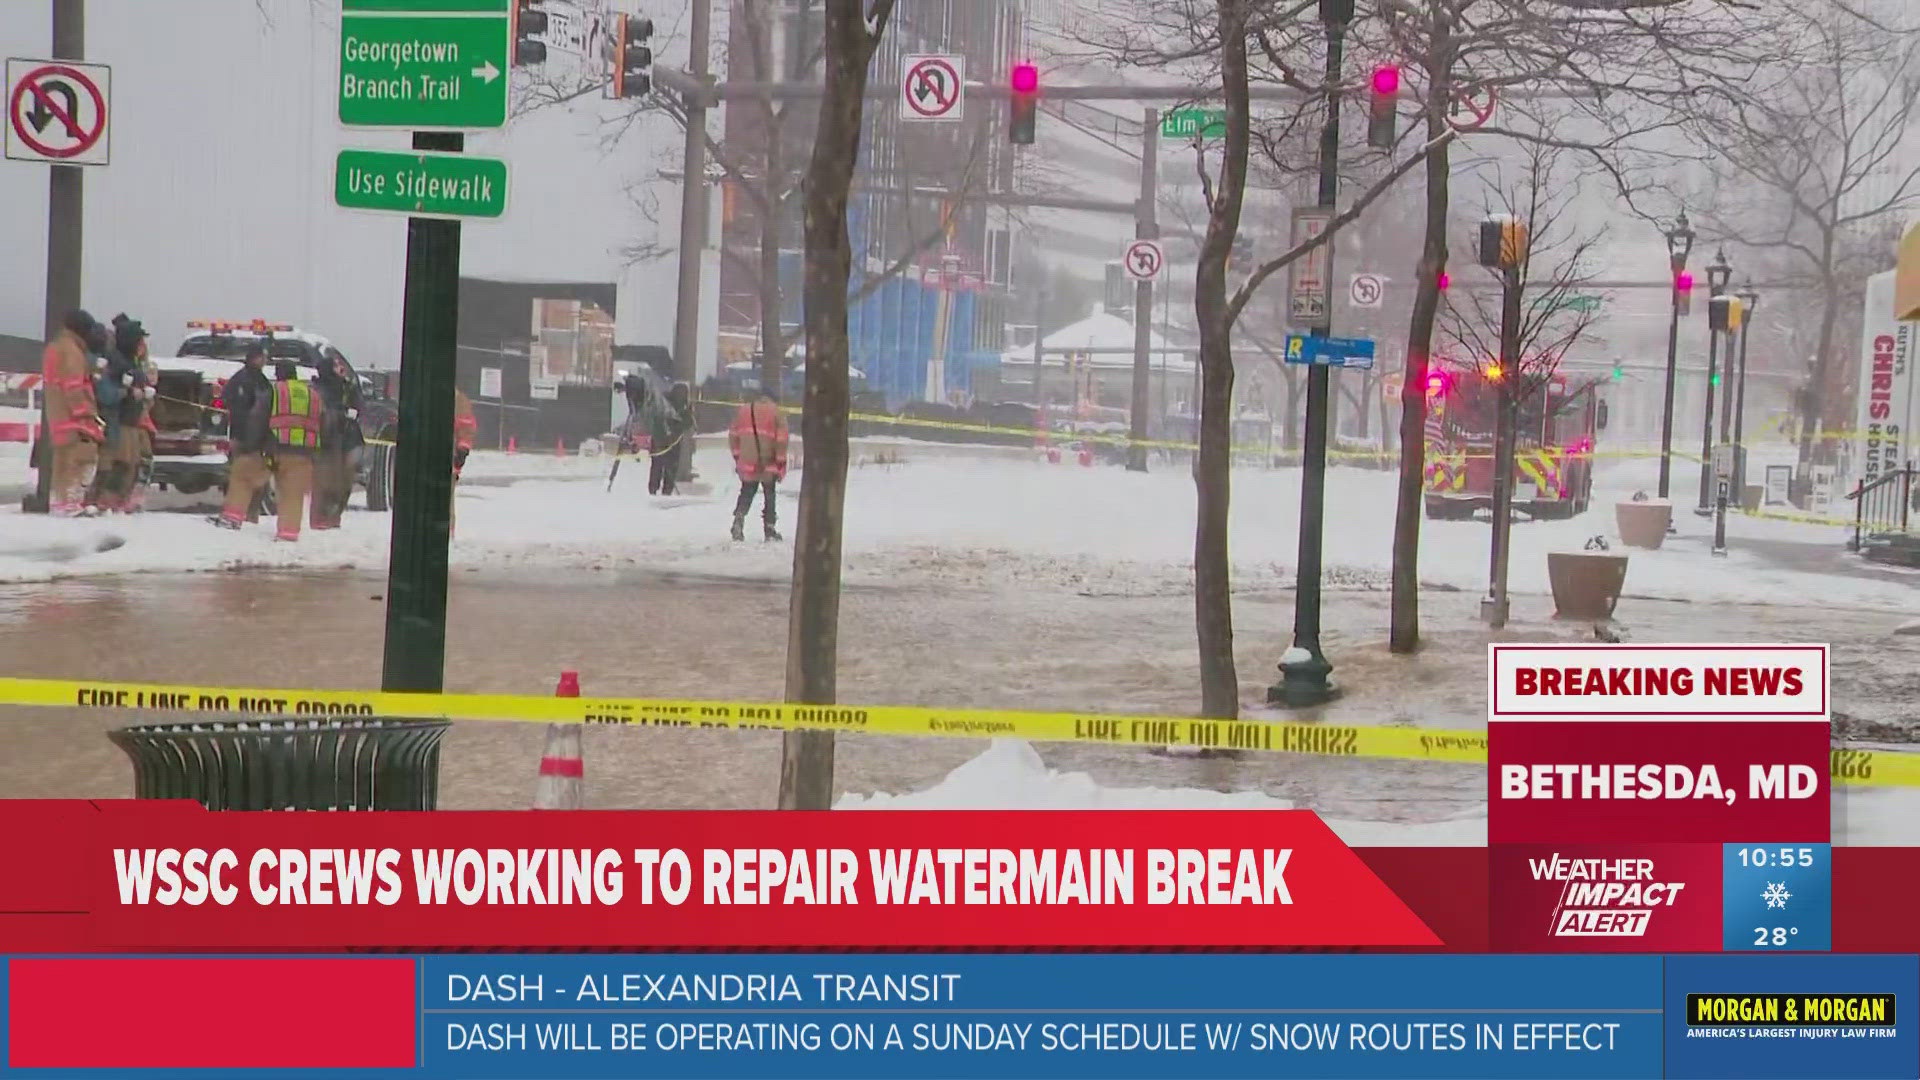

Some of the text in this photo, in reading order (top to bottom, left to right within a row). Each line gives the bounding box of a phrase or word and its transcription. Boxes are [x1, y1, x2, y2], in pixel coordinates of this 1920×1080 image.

[345, 36, 458, 69] Georgetown
[344, 74, 460, 100] Branch Trail
[1166, 114, 1196, 132] Elm
[349, 168, 492, 203] Use Sidewalk
[1869, 335, 1895, 420] CHRIS
